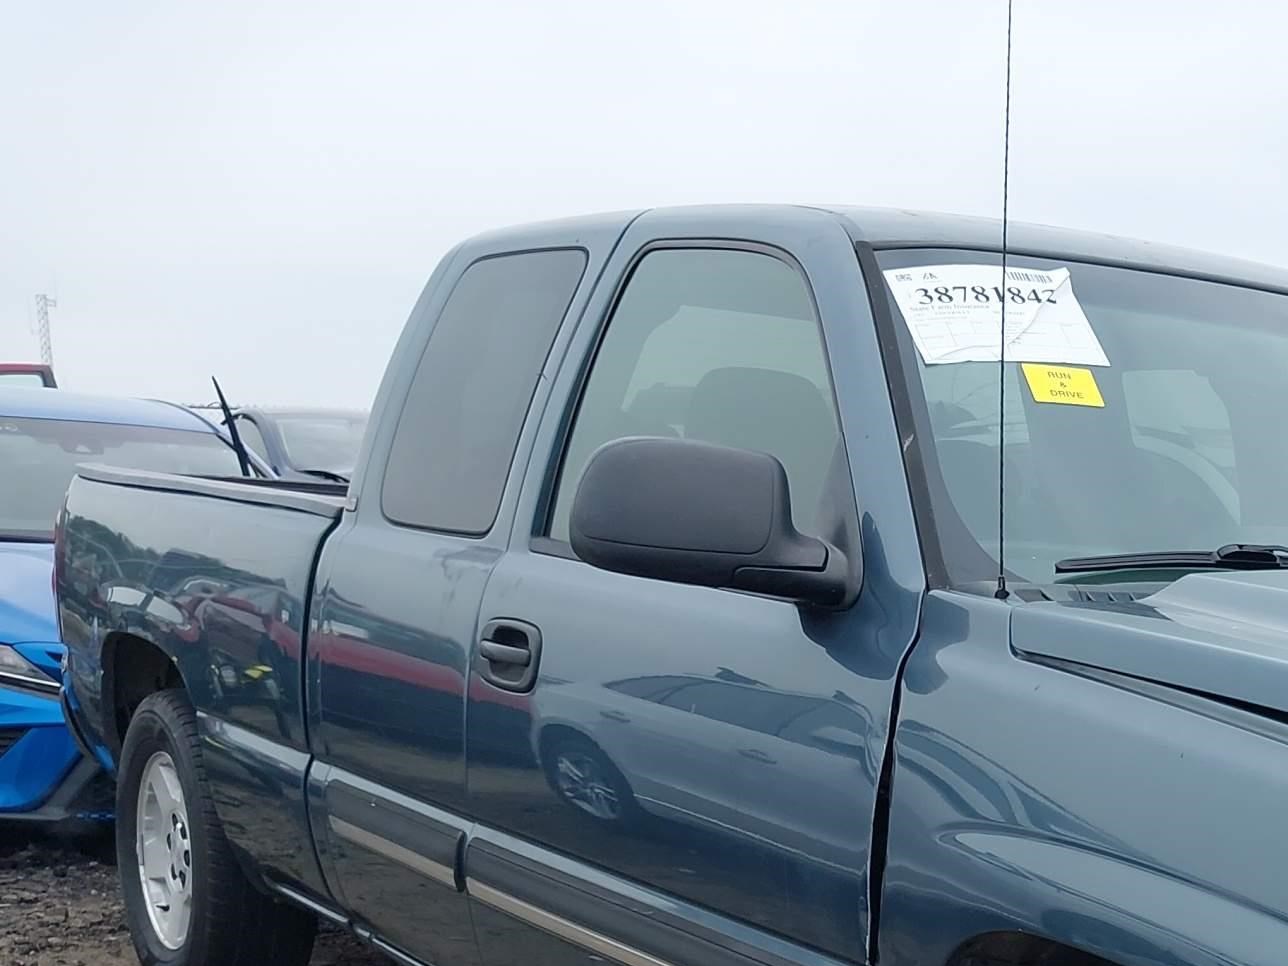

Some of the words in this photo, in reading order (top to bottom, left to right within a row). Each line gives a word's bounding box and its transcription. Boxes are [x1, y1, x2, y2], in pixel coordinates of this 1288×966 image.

[914, 286, 1057, 305] 38781842
[1047, 371, 1072, 380] RUN
[1049, 389, 1085, 399] DRIVE
